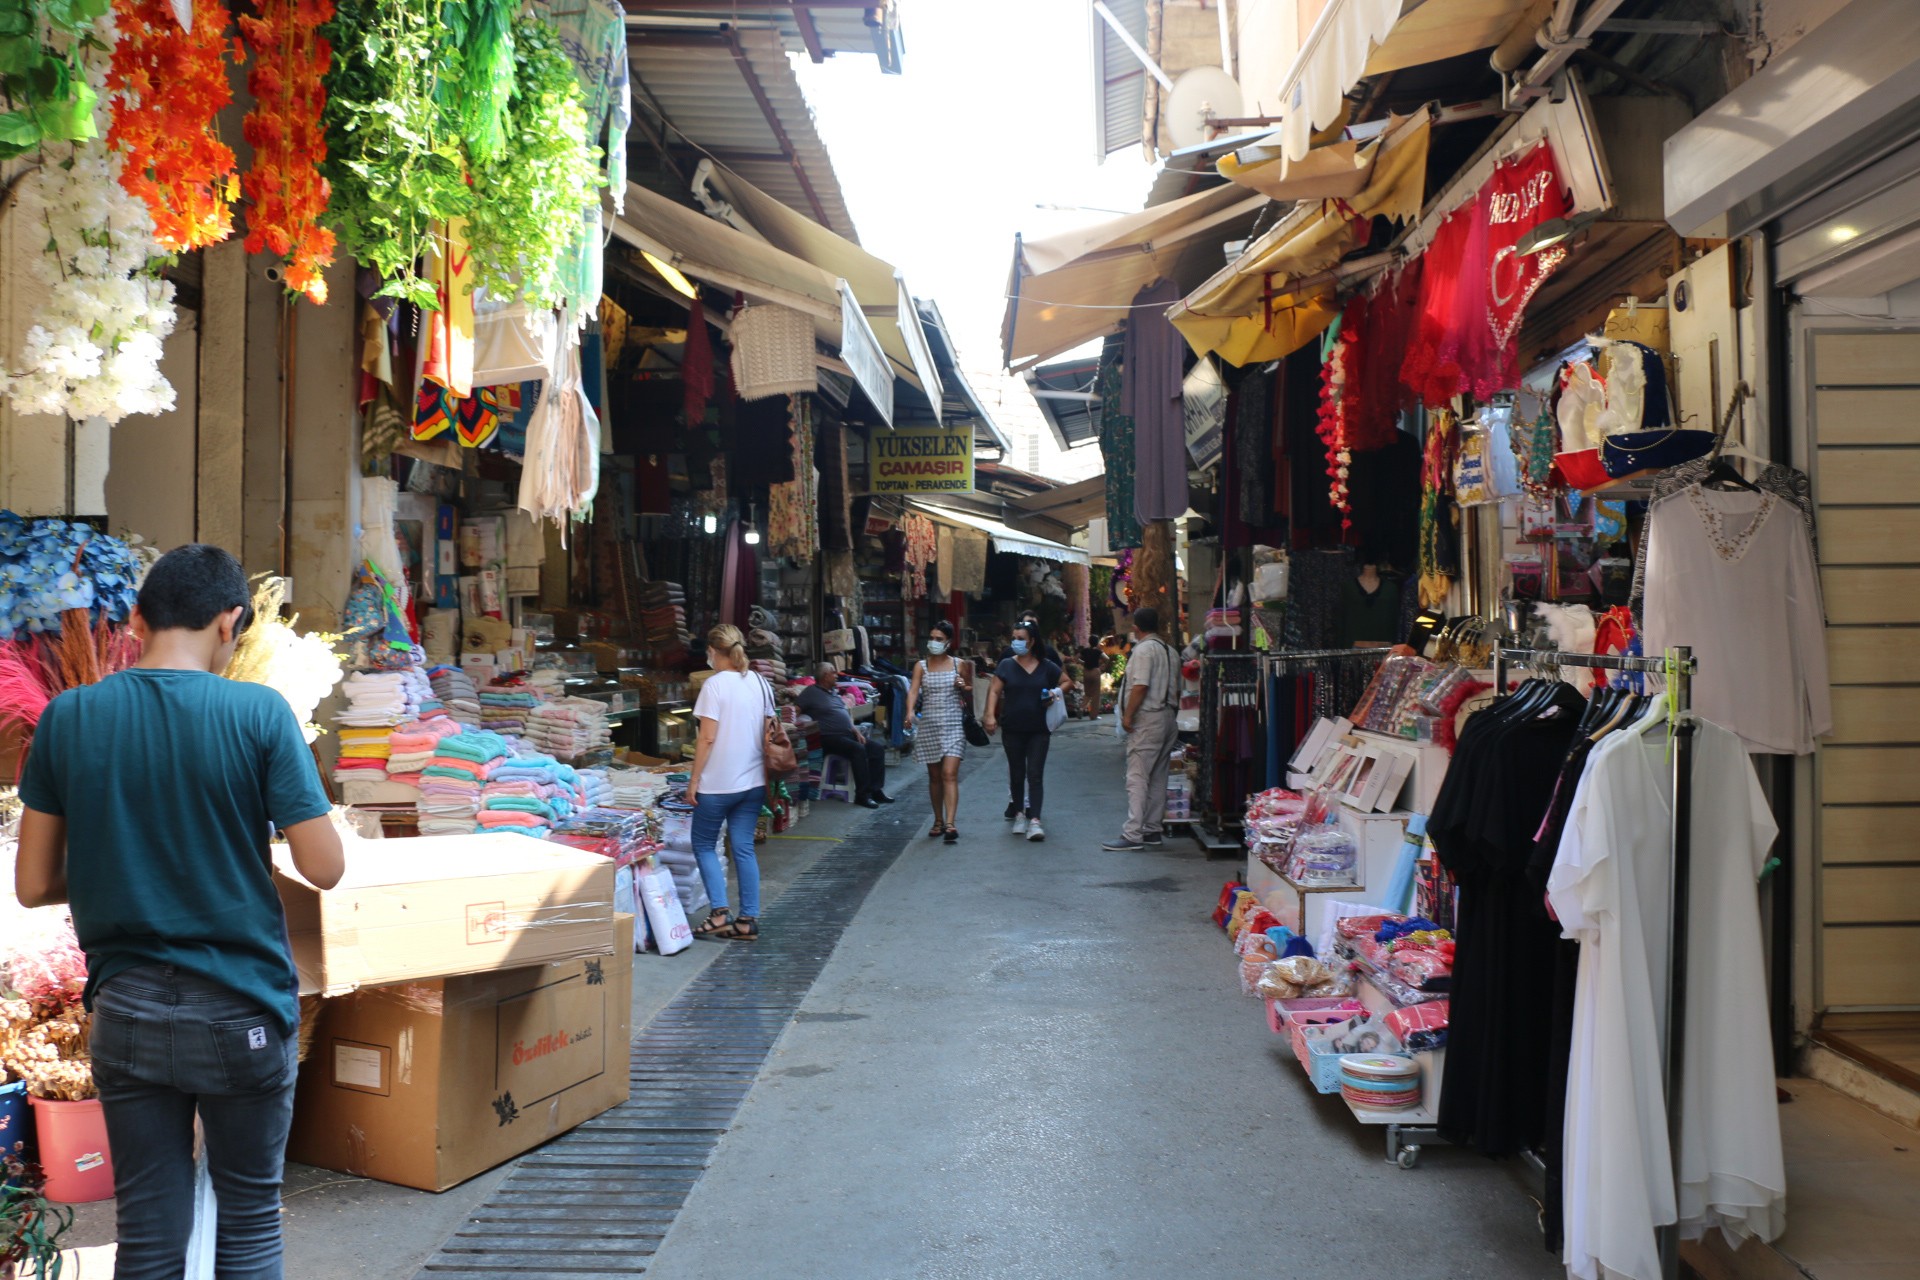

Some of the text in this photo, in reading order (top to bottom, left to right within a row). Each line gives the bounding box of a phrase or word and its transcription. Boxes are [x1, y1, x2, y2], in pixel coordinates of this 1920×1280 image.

[876, 432, 968, 457] YÜKSELEN
[879, 460, 964, 476] ÇAMAŞIR
[876, 480, 909, 490] TOPTAN
[916, 480, 967, 490] PERAKENDE
